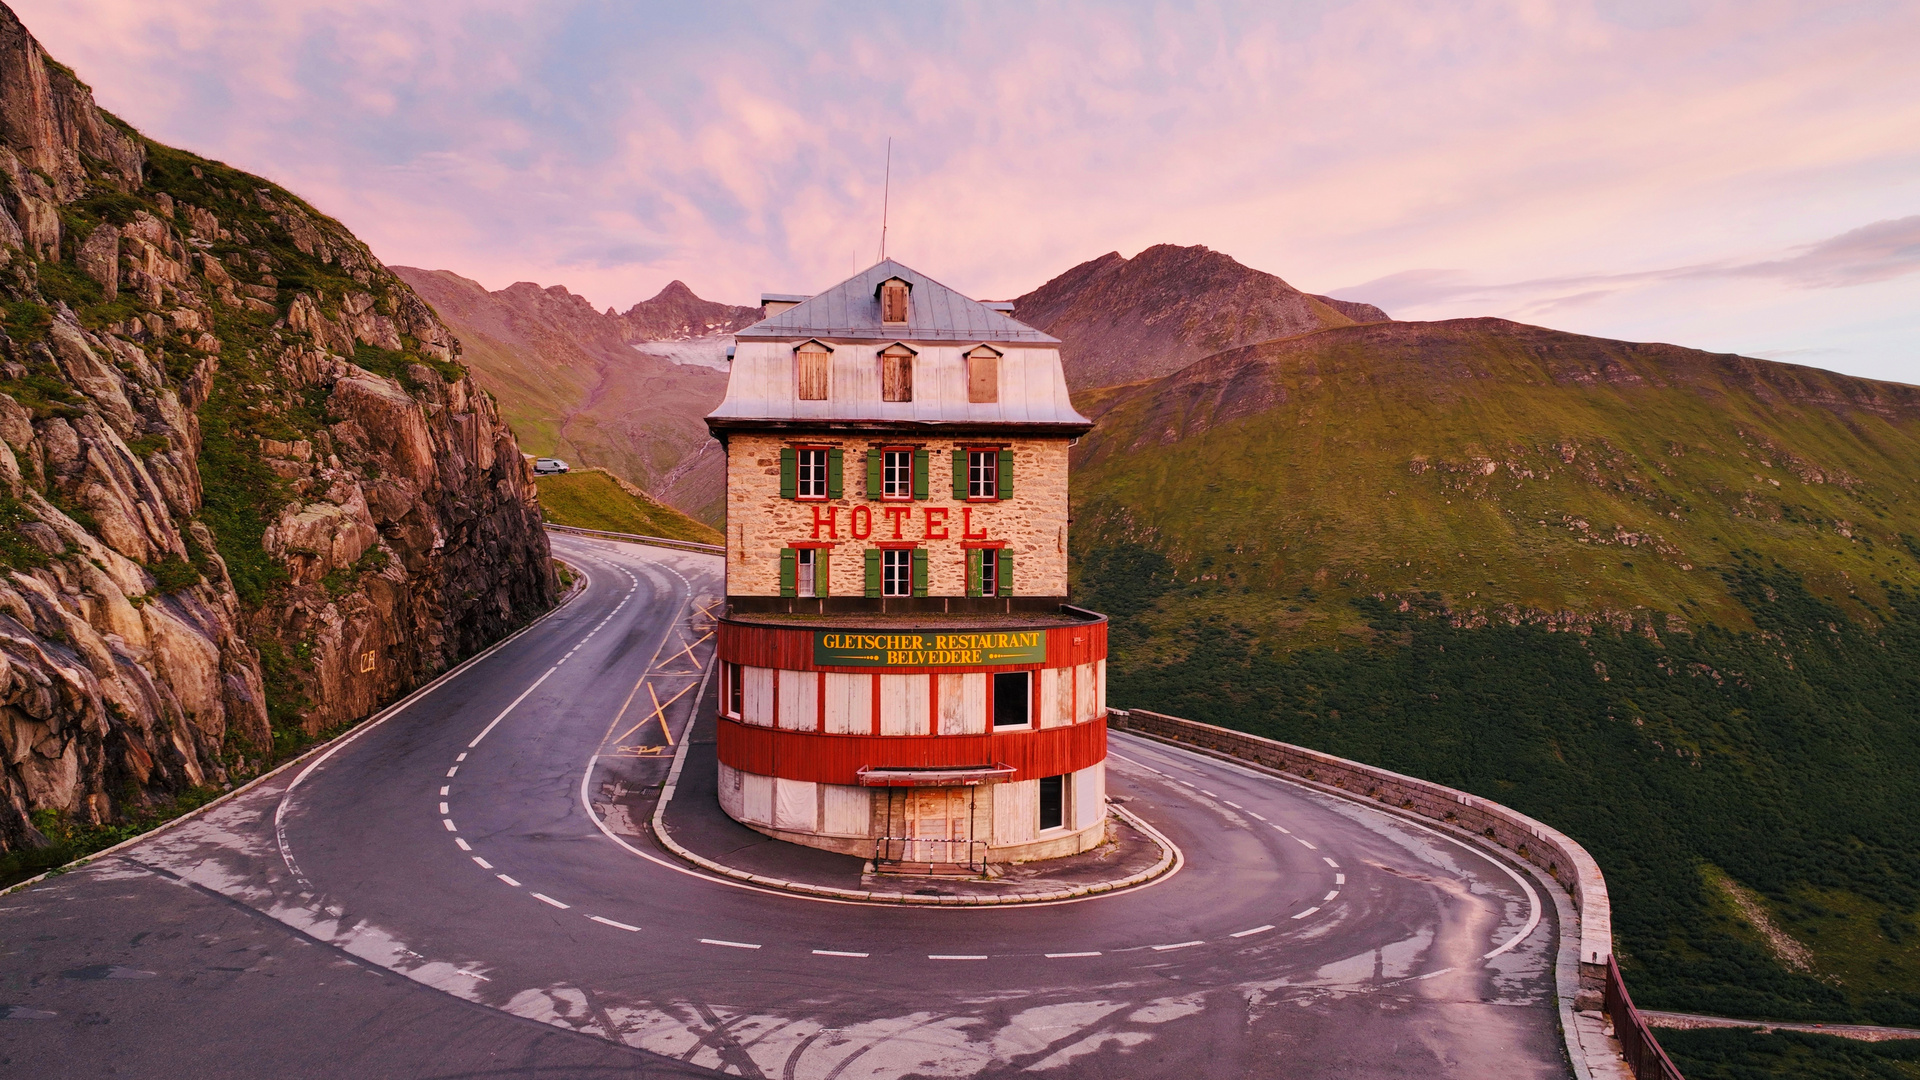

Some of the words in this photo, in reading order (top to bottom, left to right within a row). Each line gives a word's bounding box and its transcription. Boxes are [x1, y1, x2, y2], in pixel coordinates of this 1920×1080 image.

[811, 505, 988, 540] HOTEL
[823, 635, 924, 649] GLETSCHER
[935, 633, 1040, 649] RESTAURANT
[887, 650, 982, 664] BELVEDERE
